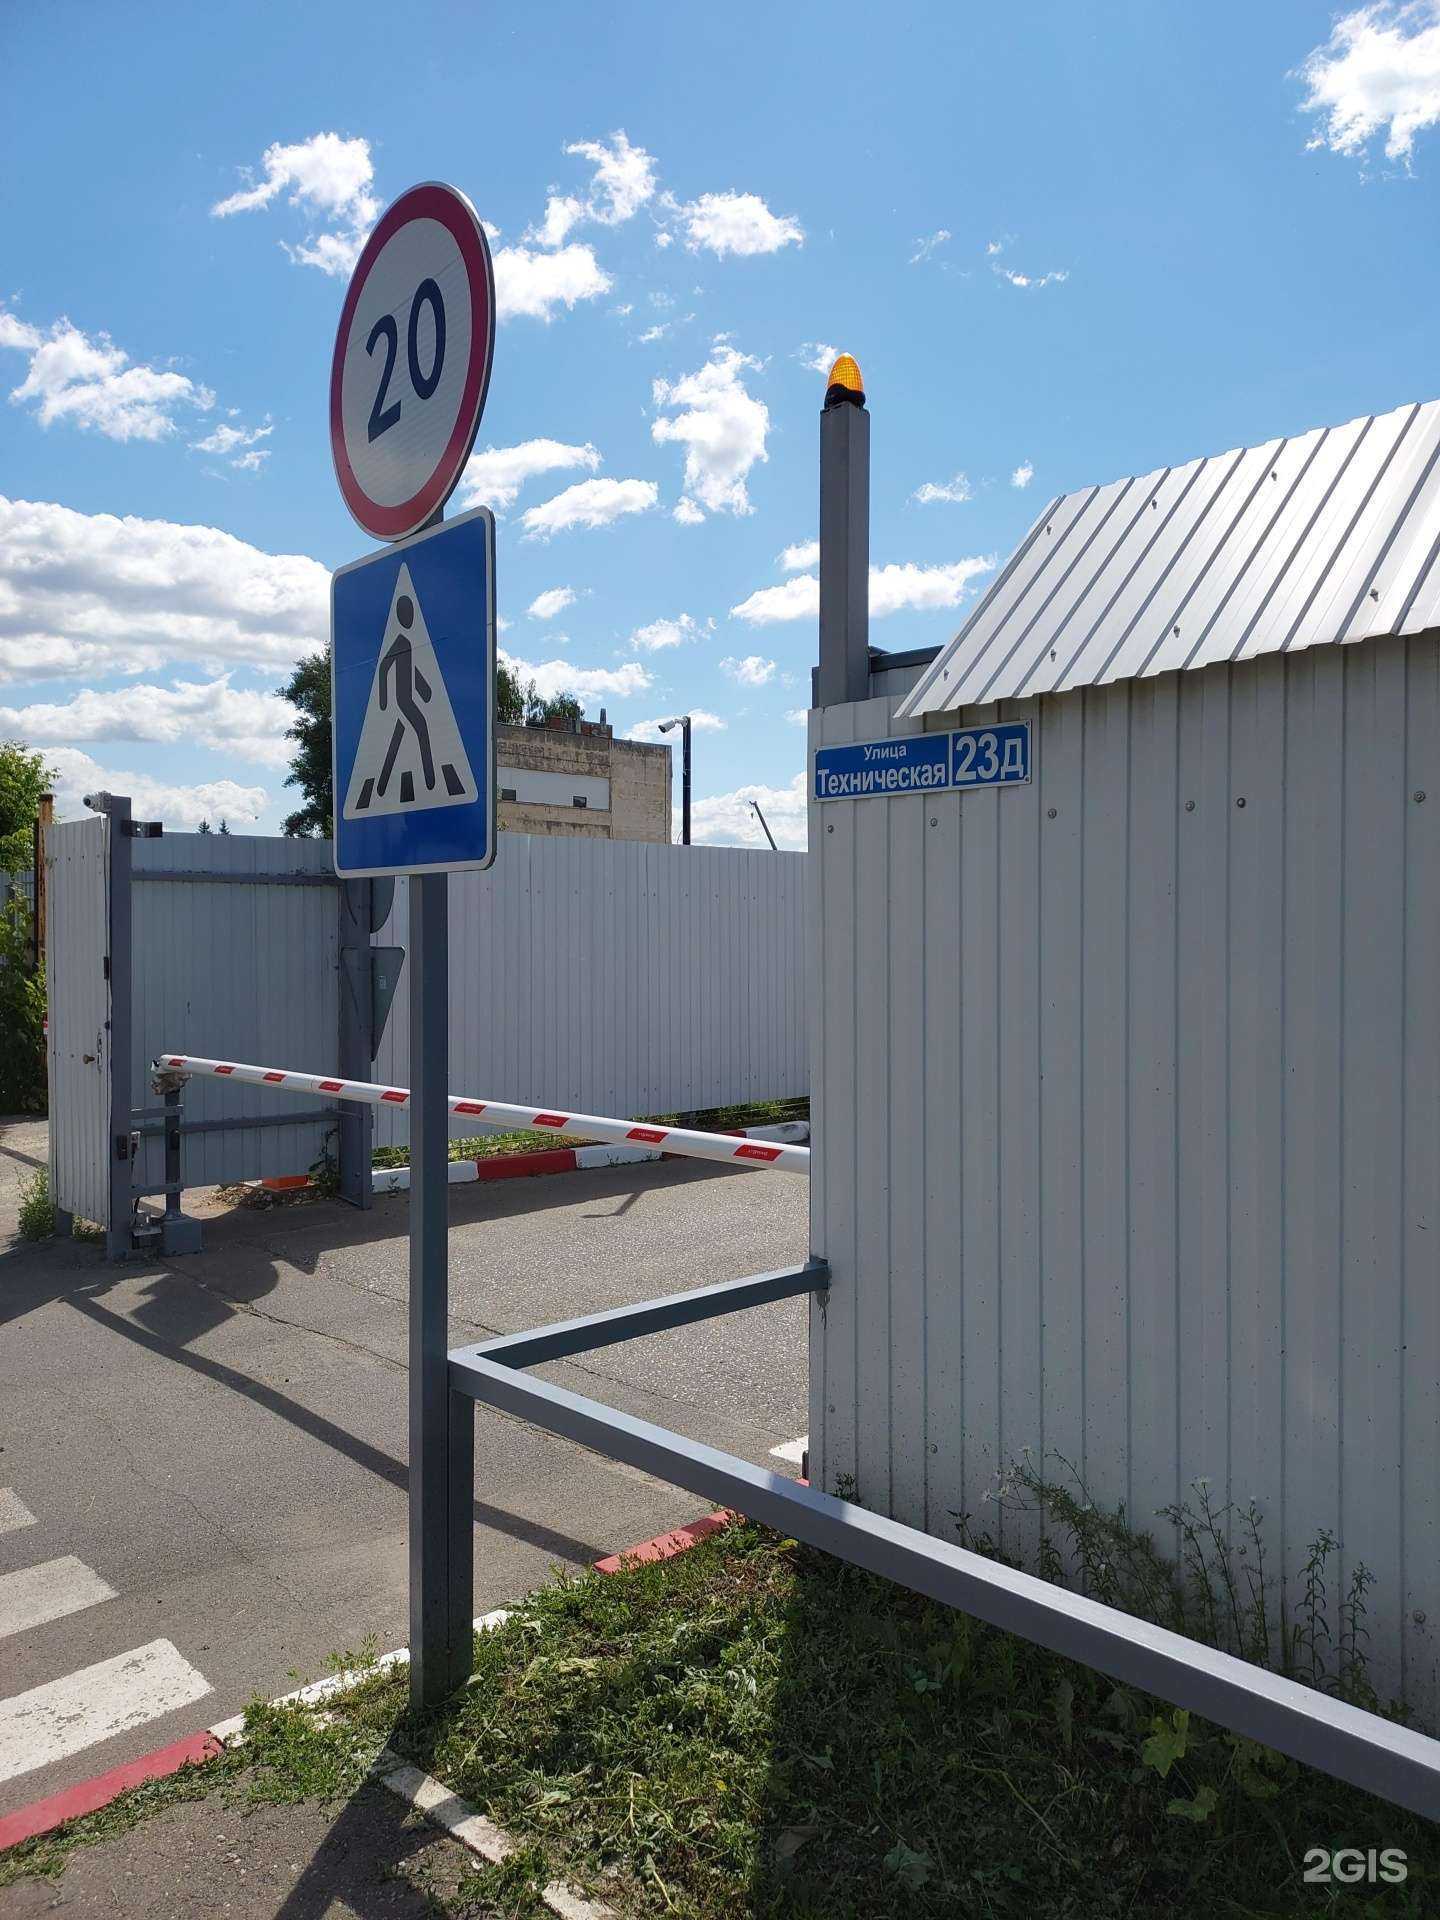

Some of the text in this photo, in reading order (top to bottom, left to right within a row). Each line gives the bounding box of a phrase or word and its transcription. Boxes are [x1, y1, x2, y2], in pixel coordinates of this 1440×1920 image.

[366, 278, 446, 442] 20
[864, 745, 907, 761] Улица
[817, 764, 946, 795] Техническая
